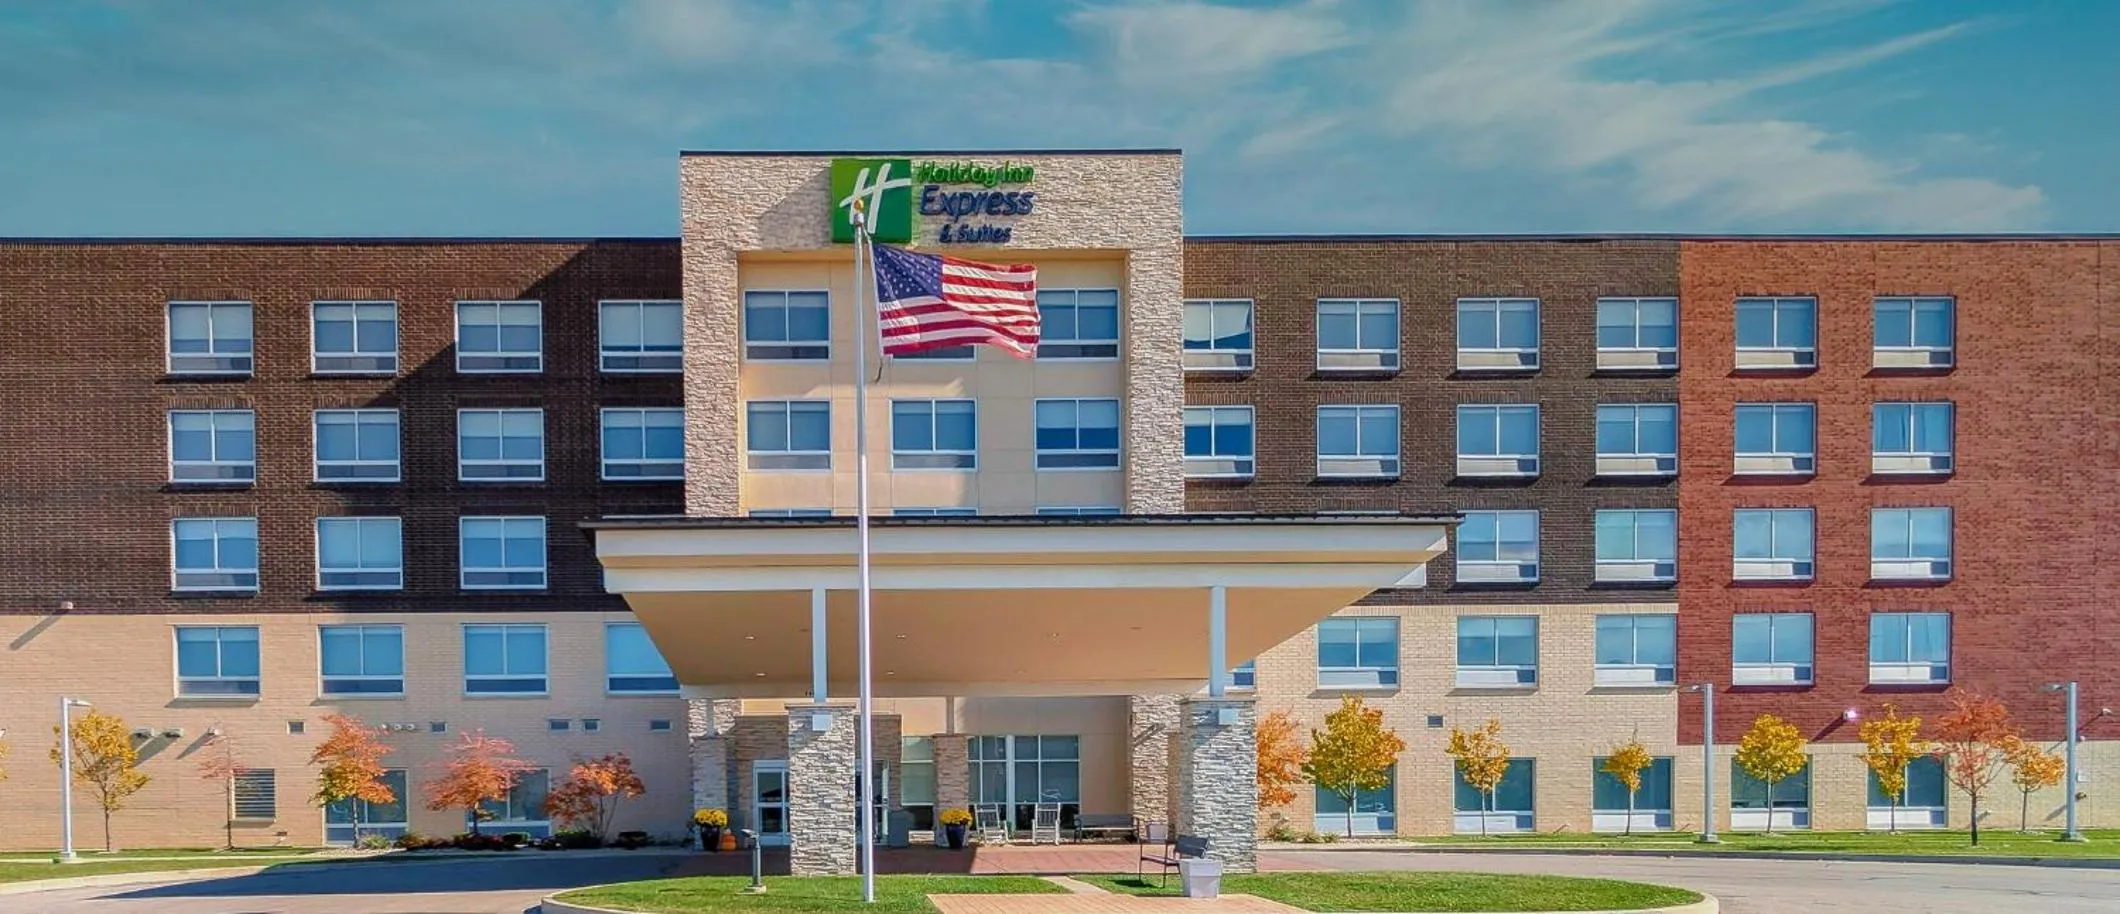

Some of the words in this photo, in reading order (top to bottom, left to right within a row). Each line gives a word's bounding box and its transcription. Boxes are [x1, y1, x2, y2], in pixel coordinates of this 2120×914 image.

[918, 161, 998, 188] Holiday
[1001, 161, 1035, 183] Inn
[839, 163, 911, 234] H
[919, 185, 1034, 223] Express
[939, 224, 953, 243] &
[958, 224, 1012, 243] Suites
